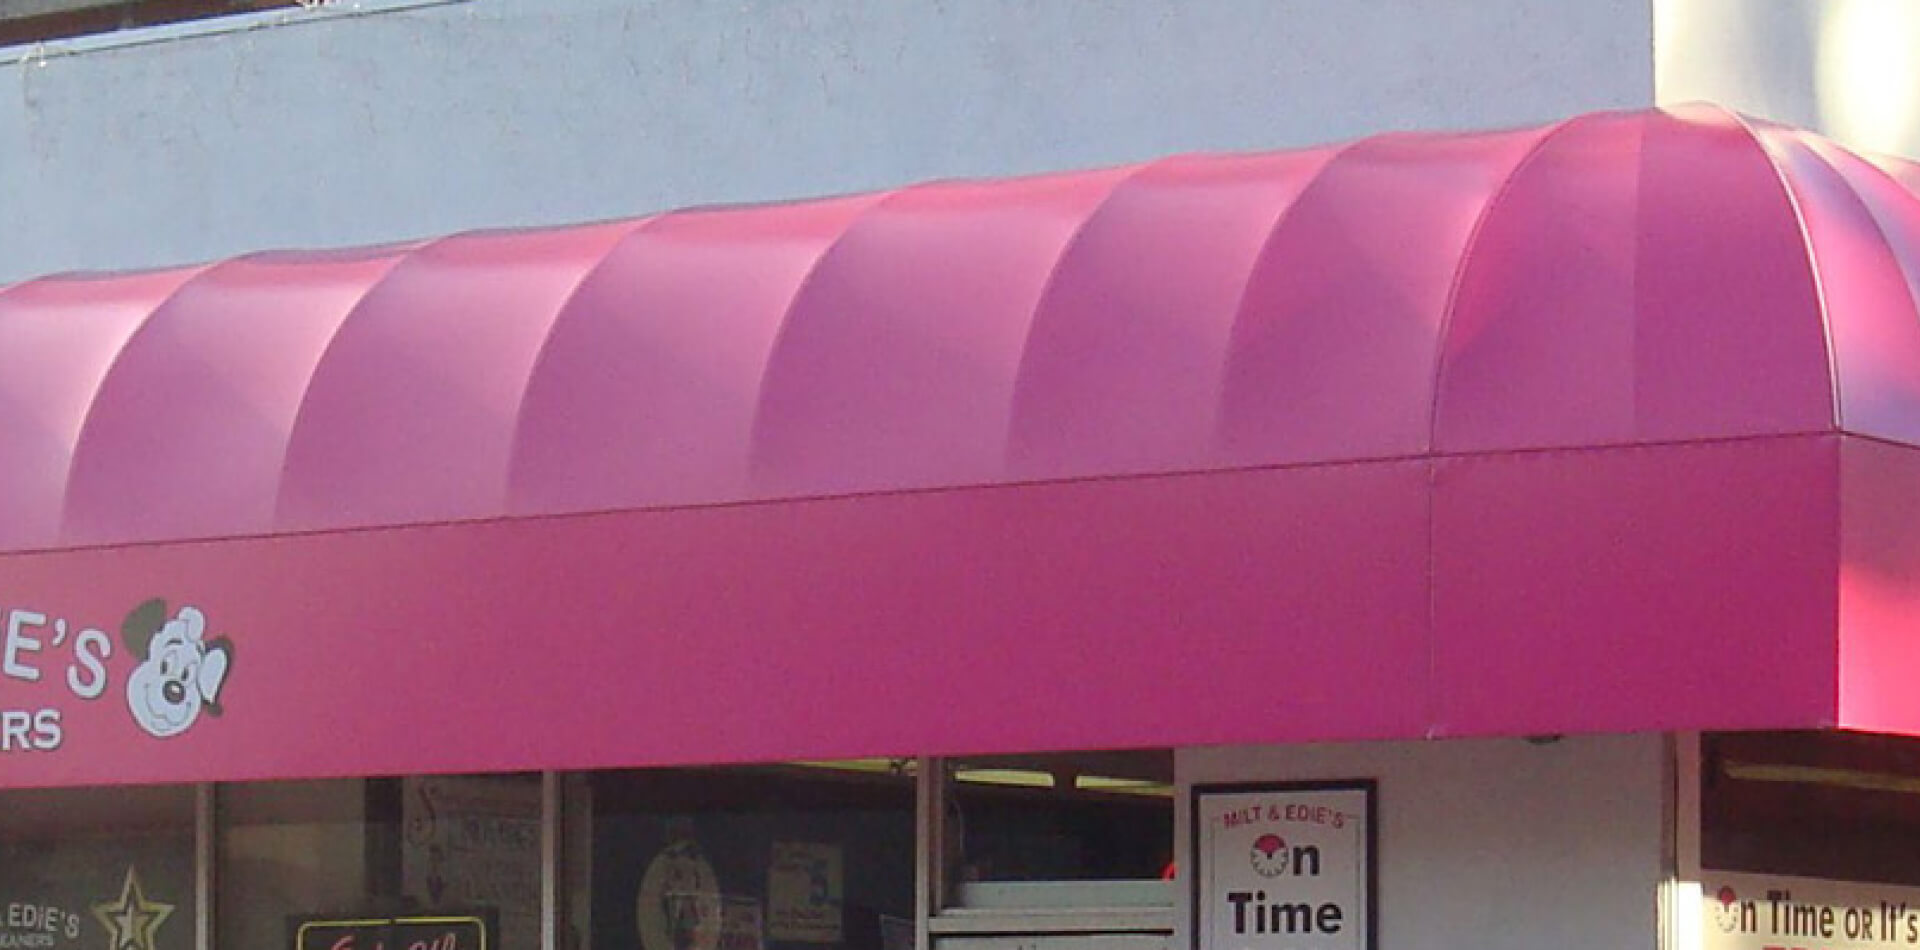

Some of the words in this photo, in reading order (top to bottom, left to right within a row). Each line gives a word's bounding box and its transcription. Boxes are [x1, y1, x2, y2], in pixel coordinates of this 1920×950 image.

[1, 708, 62, 750] RS
[1226, 890, 1343, 935] Time
[1766, 888, 1835, 938] Time
[1845, 905, 1873, 940] OR
[1880, 901, 1918, 944] It's
